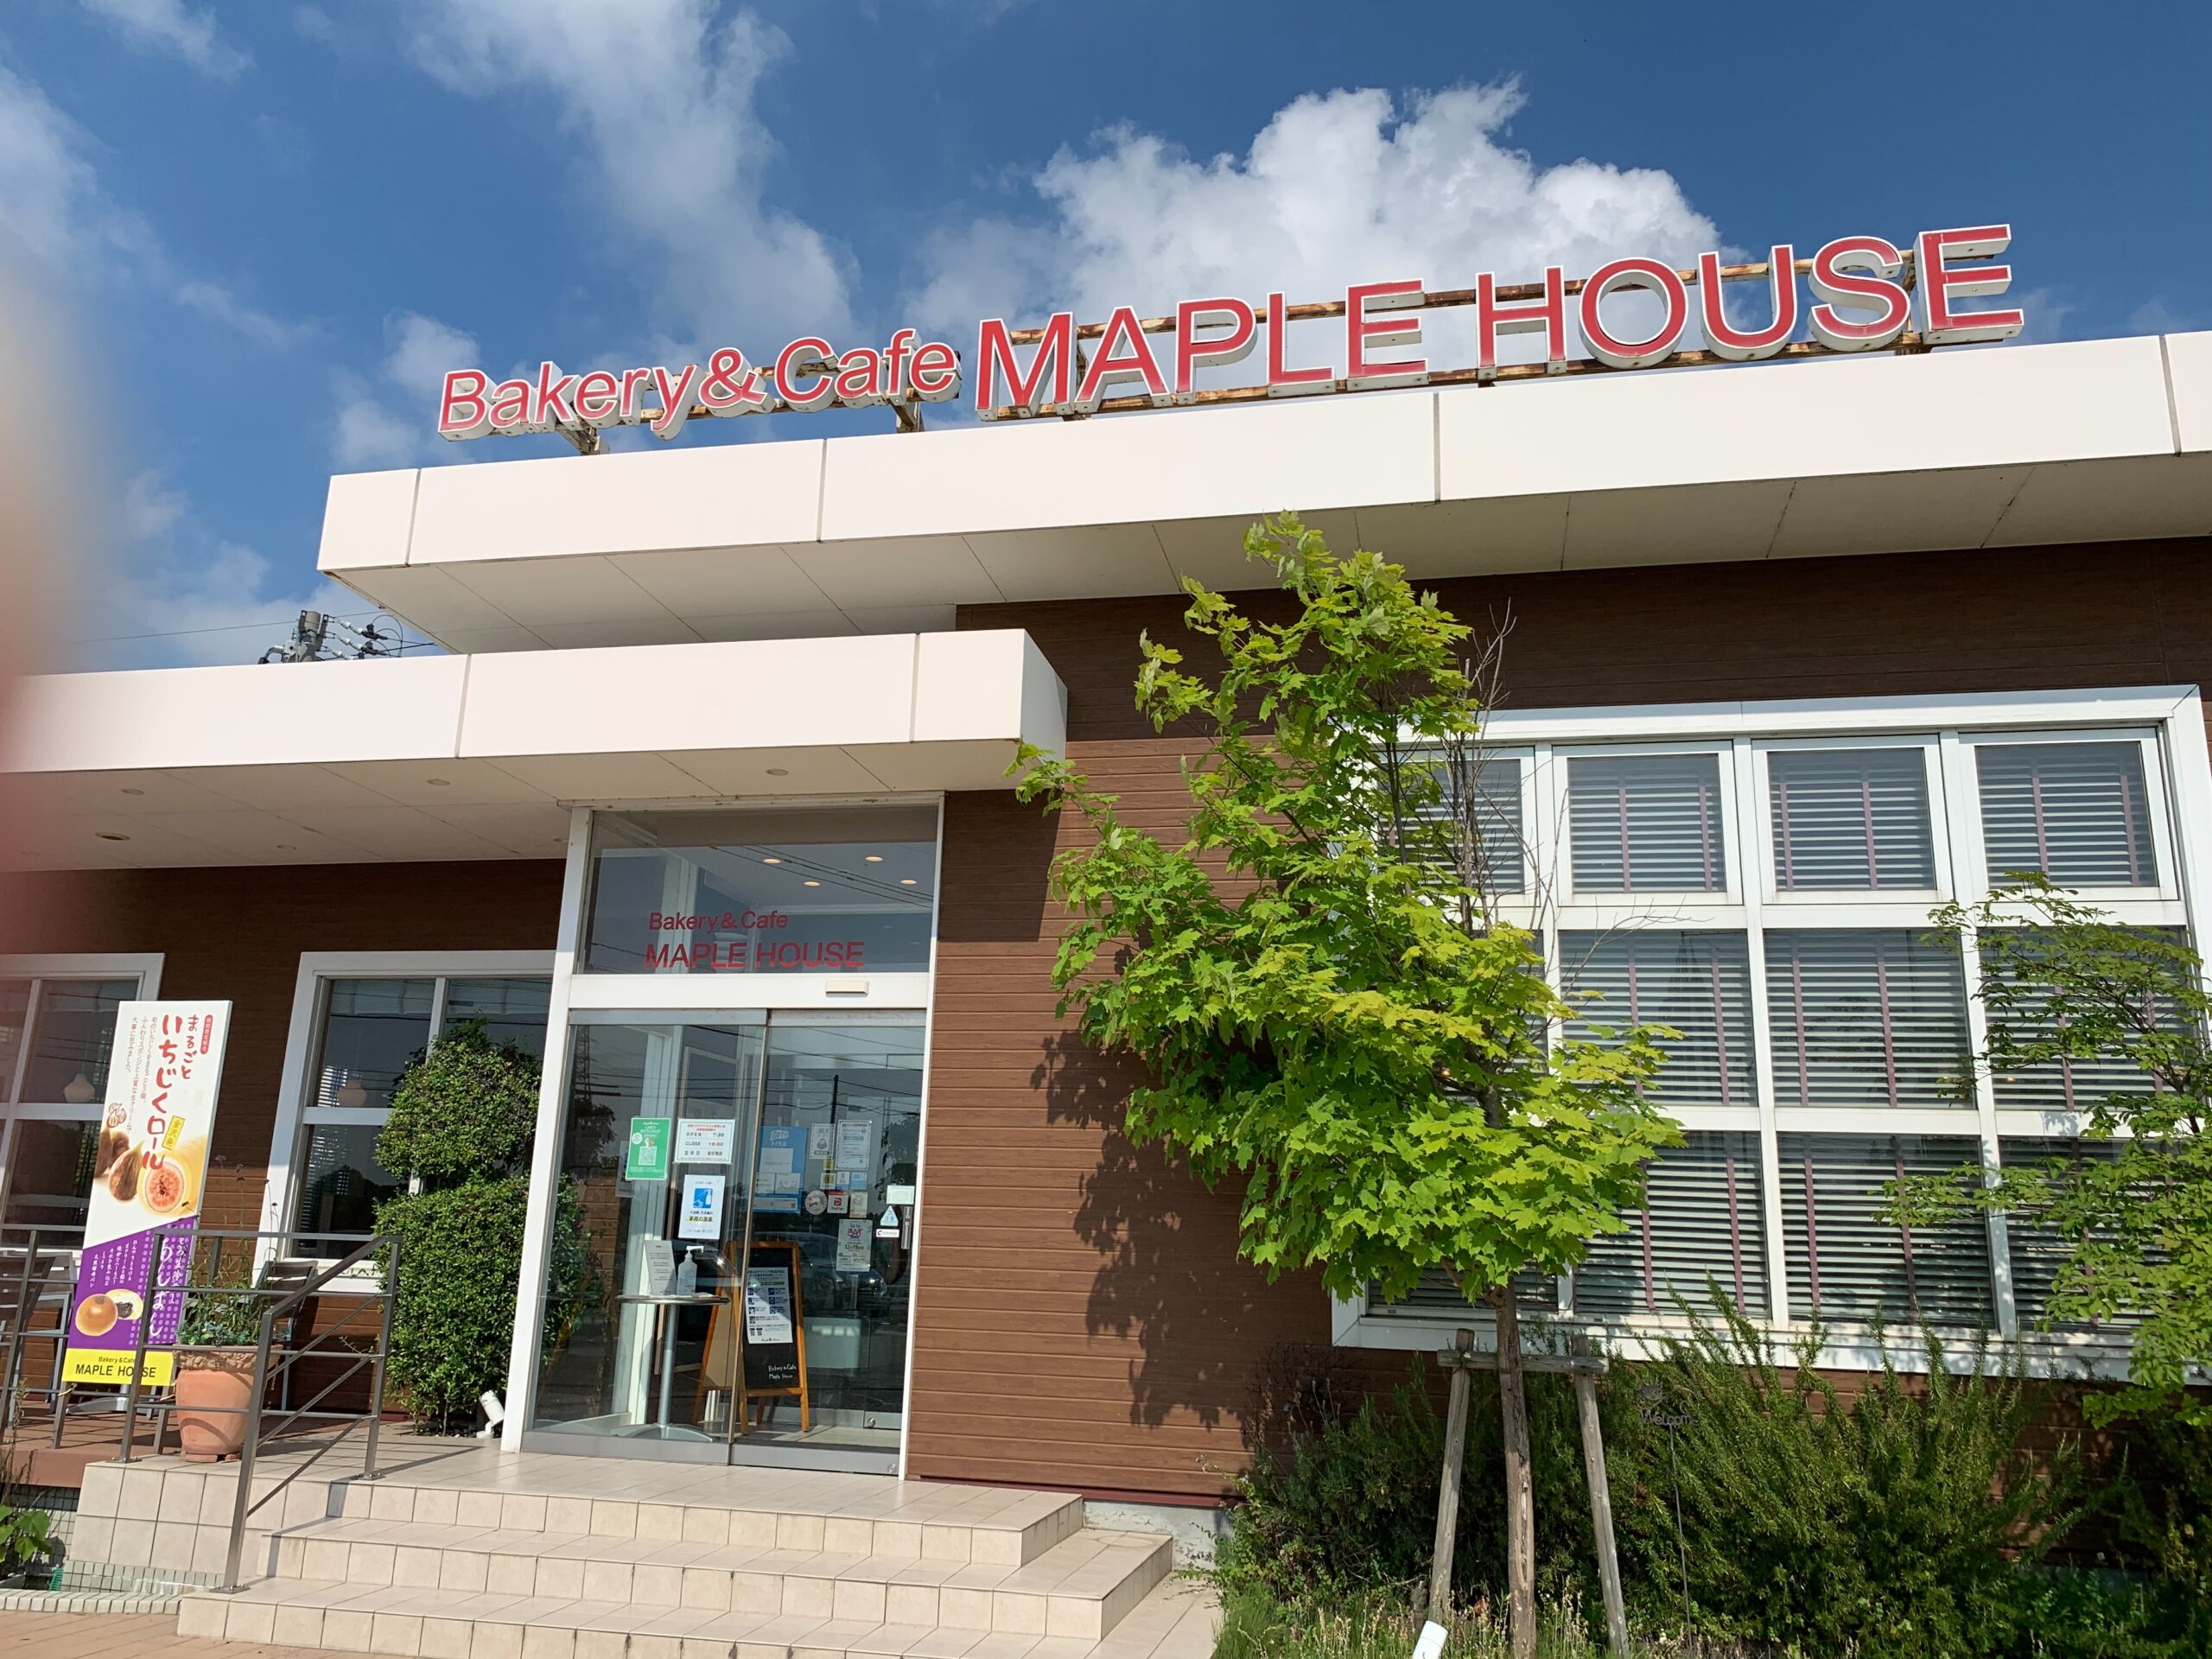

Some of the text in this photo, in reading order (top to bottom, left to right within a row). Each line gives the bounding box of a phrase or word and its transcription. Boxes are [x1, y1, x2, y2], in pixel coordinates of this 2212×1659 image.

[776, 327, 963, 413] Cafe
[976, 277, 1431, 422] MAPLE
[1476, 223, 2024, 380] HOUSE
[741, 910, 789, 930] Cafe
[644, 940, 867, 969] MAPLE HOUSE
[182, 1014, 200, 1080] まるごと
[142, 1014, 183, 1170] いちじくロール
[75, 1364, 156, 1378] MAPLE HOSE
